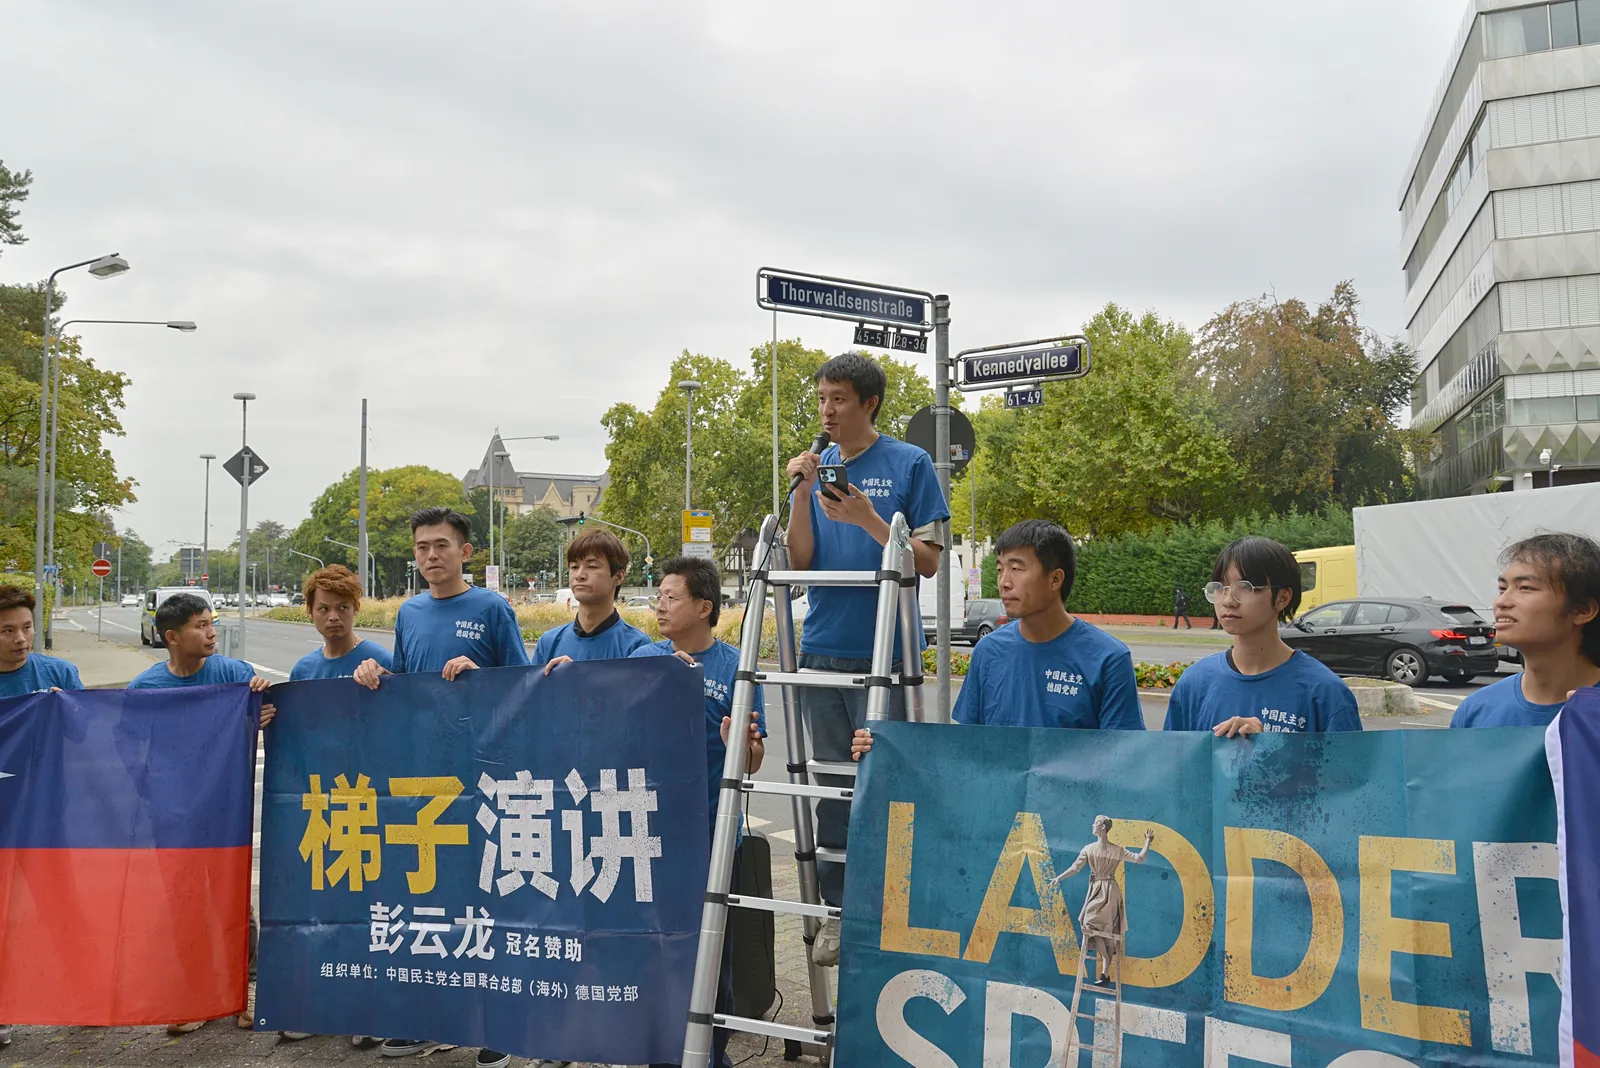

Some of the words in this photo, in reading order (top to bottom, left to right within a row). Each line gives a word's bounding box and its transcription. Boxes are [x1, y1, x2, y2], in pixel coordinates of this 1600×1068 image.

[780, 281, 913, 318] Thorwaldsenstraße
[856, 330, 888, 348] 45-51
[895, 333, 925, 350] 28-36
[973, 352, 1068, 377] Kennedyallee
[1007, 391, 1041, 406] 61-49
[861, 478, 892, 487] 中国民主党
[455, 620, 485, 632] 中国民主党
[1045, 669, 1083, 685] 中国民主党
[1046, 682, 1078, 696] 德国党部
[1261, 707, 1306, 729] 中国民主党
[298, 767, 662, 904] 梯子演讲
[368, 901, 496, 960] 彭云龙
[505, 932, 583, 962] 冠名赞助
